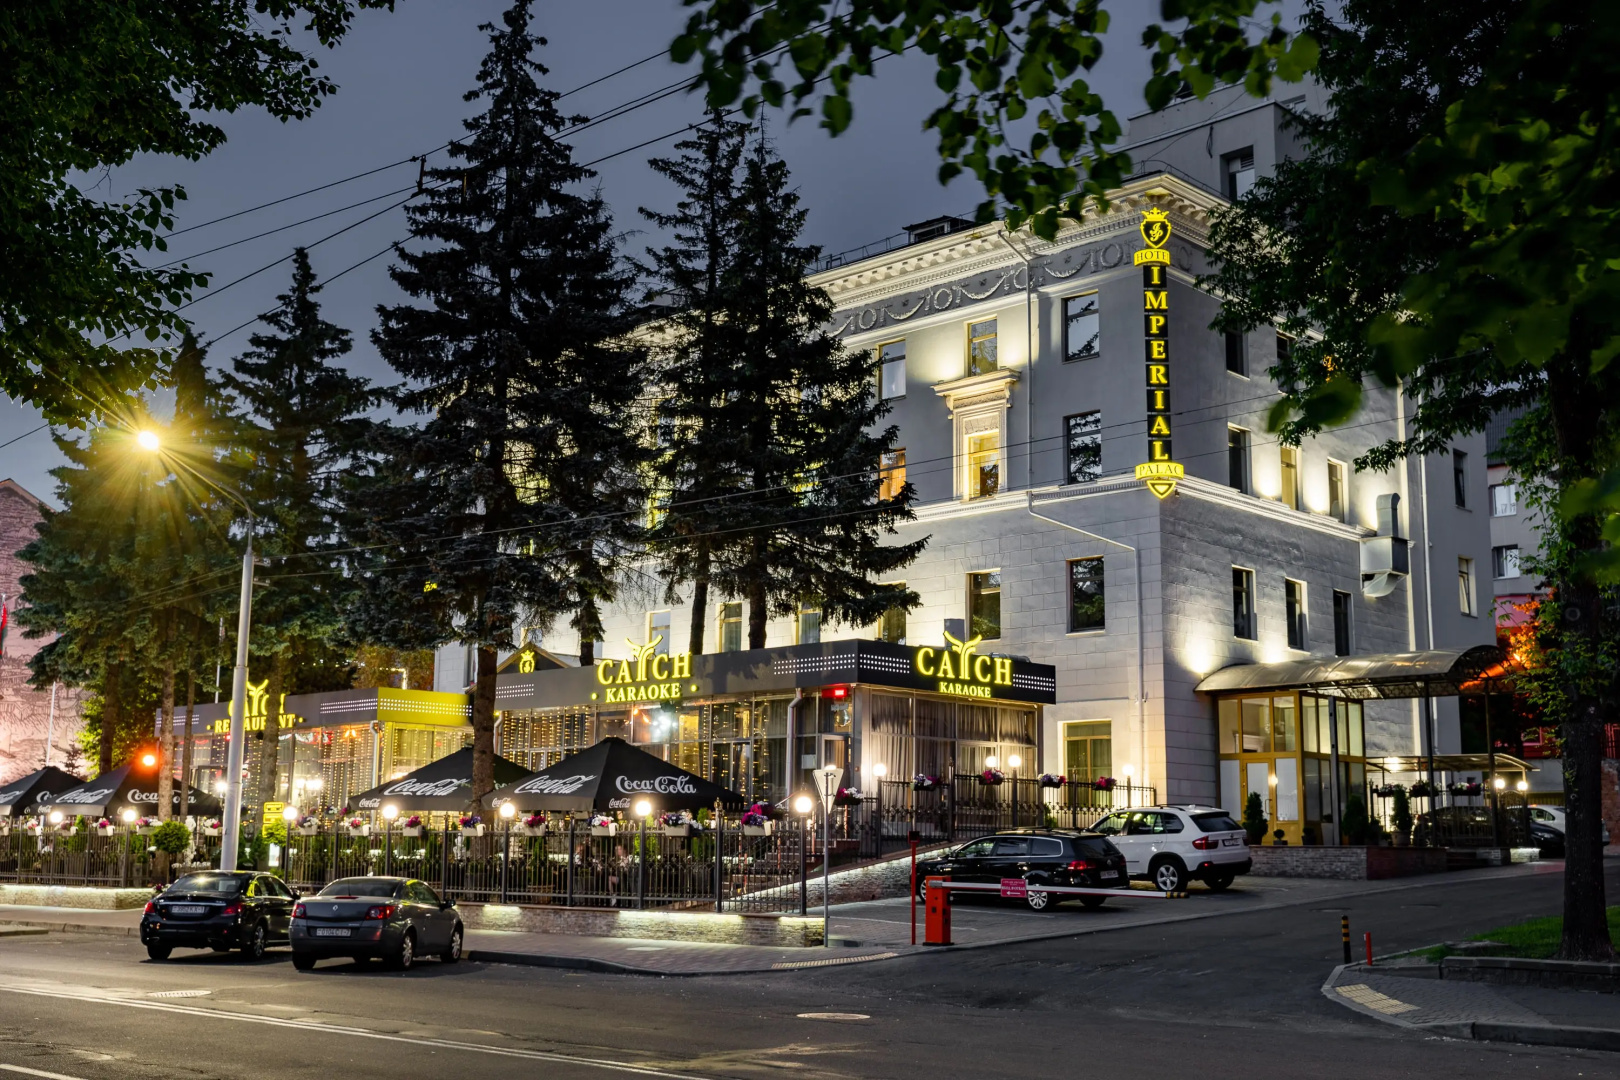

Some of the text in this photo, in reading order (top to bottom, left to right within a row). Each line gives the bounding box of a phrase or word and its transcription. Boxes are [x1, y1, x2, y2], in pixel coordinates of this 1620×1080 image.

[1144, 266, 1171, 460] IMPERIAL
[1139, 464, 1183, 476] PALAC
[597, 635, 692, 685] CATCH
[917, 631, 1012, 685] CATCH
[605, 682, 681, 703] KARAOKE
[939, 681, 991, 698] KARAOKE
